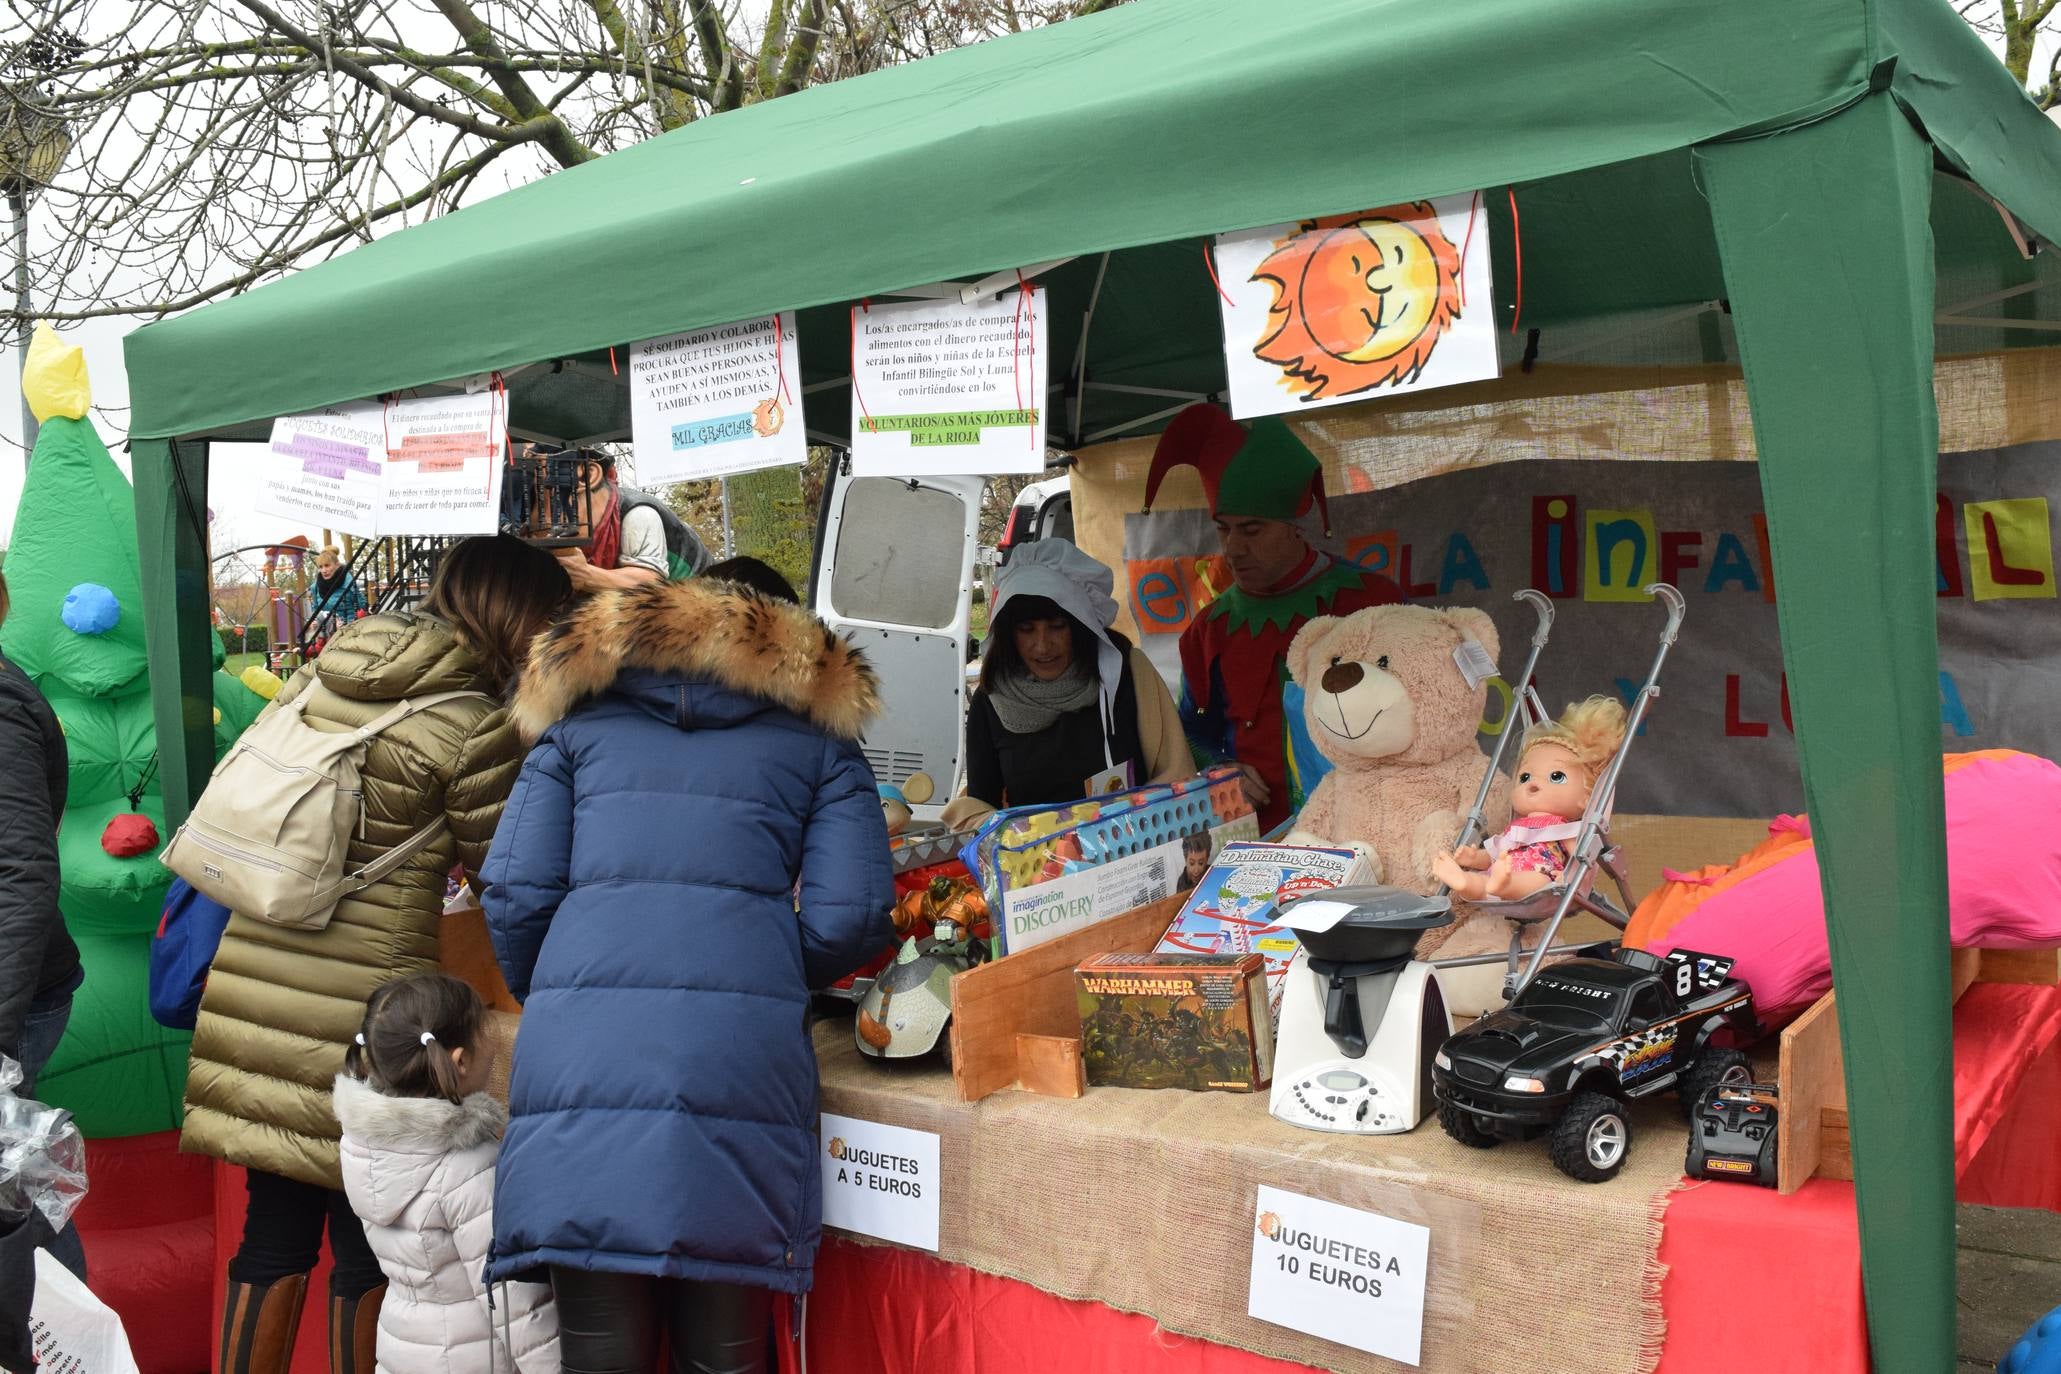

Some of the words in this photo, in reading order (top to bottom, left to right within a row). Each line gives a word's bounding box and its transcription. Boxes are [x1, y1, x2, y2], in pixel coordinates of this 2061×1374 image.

[965, 316, 977, 327] de
[656, 333, 709, 354] SOLIDARIO
[711, 331, 719, 341] Y
[868, 339, 913, 350] alimentos
[915, 339, 931, 347] con
[934, 335, 942, 346] el
[944, 334, 976, 345] dinero
[633, 356, 677, 373] PROCURA
[680, 351, 700, 365] QUE
[703, 345, 720, 358] TUS
[723, 339, 753, 354] HIJOS
[865, 355, 890, 367] serán
[893, 354, 905, 365] los
[908, 353, 932, 364] niños
[934, 354, 939, 364] y
[943, 350, 969, 361] niñas
[972, 349, 983, 359] de
[986, 348, 994, 358] la
[645, 371, 669, 384] SEAN
[672, 363, 710, 379] BUENAS
[882, 369, 916, 381] Infantil
[919, 367, 957, 381] Bilingüe
[960, 365, 976, 377] Sol
[978, 368, 984, 378] y
[650, 382, 688, 398] AYUDEN
[691, 381, 697, 390] A
[898, 383, 966, 397] convirtiéndose
[968, 384, 980, 392] en
[983, 381, 996, 391] los
[657, 392, 700, 411] TAMBIÉN
[704, 394, 710, 402] A
[712, 389, 732, 401] LOS
[672, 430, 695, 445] MIL
[699, 418, 753, 444] GRACIAS
[911, 433, 925, 444] DE
[929, 432, 943, 444] LA
[946, 431, 980, 443] RIOJA
[453, 501, 468, 511] para
[1221, 849, 1299, 865] Dalmatian
[1013, 889, 1064, 913] imagination
[1014, 894, 1095, 936] DISCOVERY
[1082, 978, 1197, 997] WARHAMMER
[1676, 964, 1692, 998] 8
[840, 1145, 919, 1176] JUGUETES
[837, 1168, 848, 1183] A
[854, 1171, 862, 1186] 5
[868, 1174, 922, 1199] EUROS
[1268, 1224, 1381, 1269] JUGUETES
[1385, 1256, 1402, 1276] A
[1276, 1254, 1300, 1275] 10
[1308, 1261, 1383, 1299] EUROS
